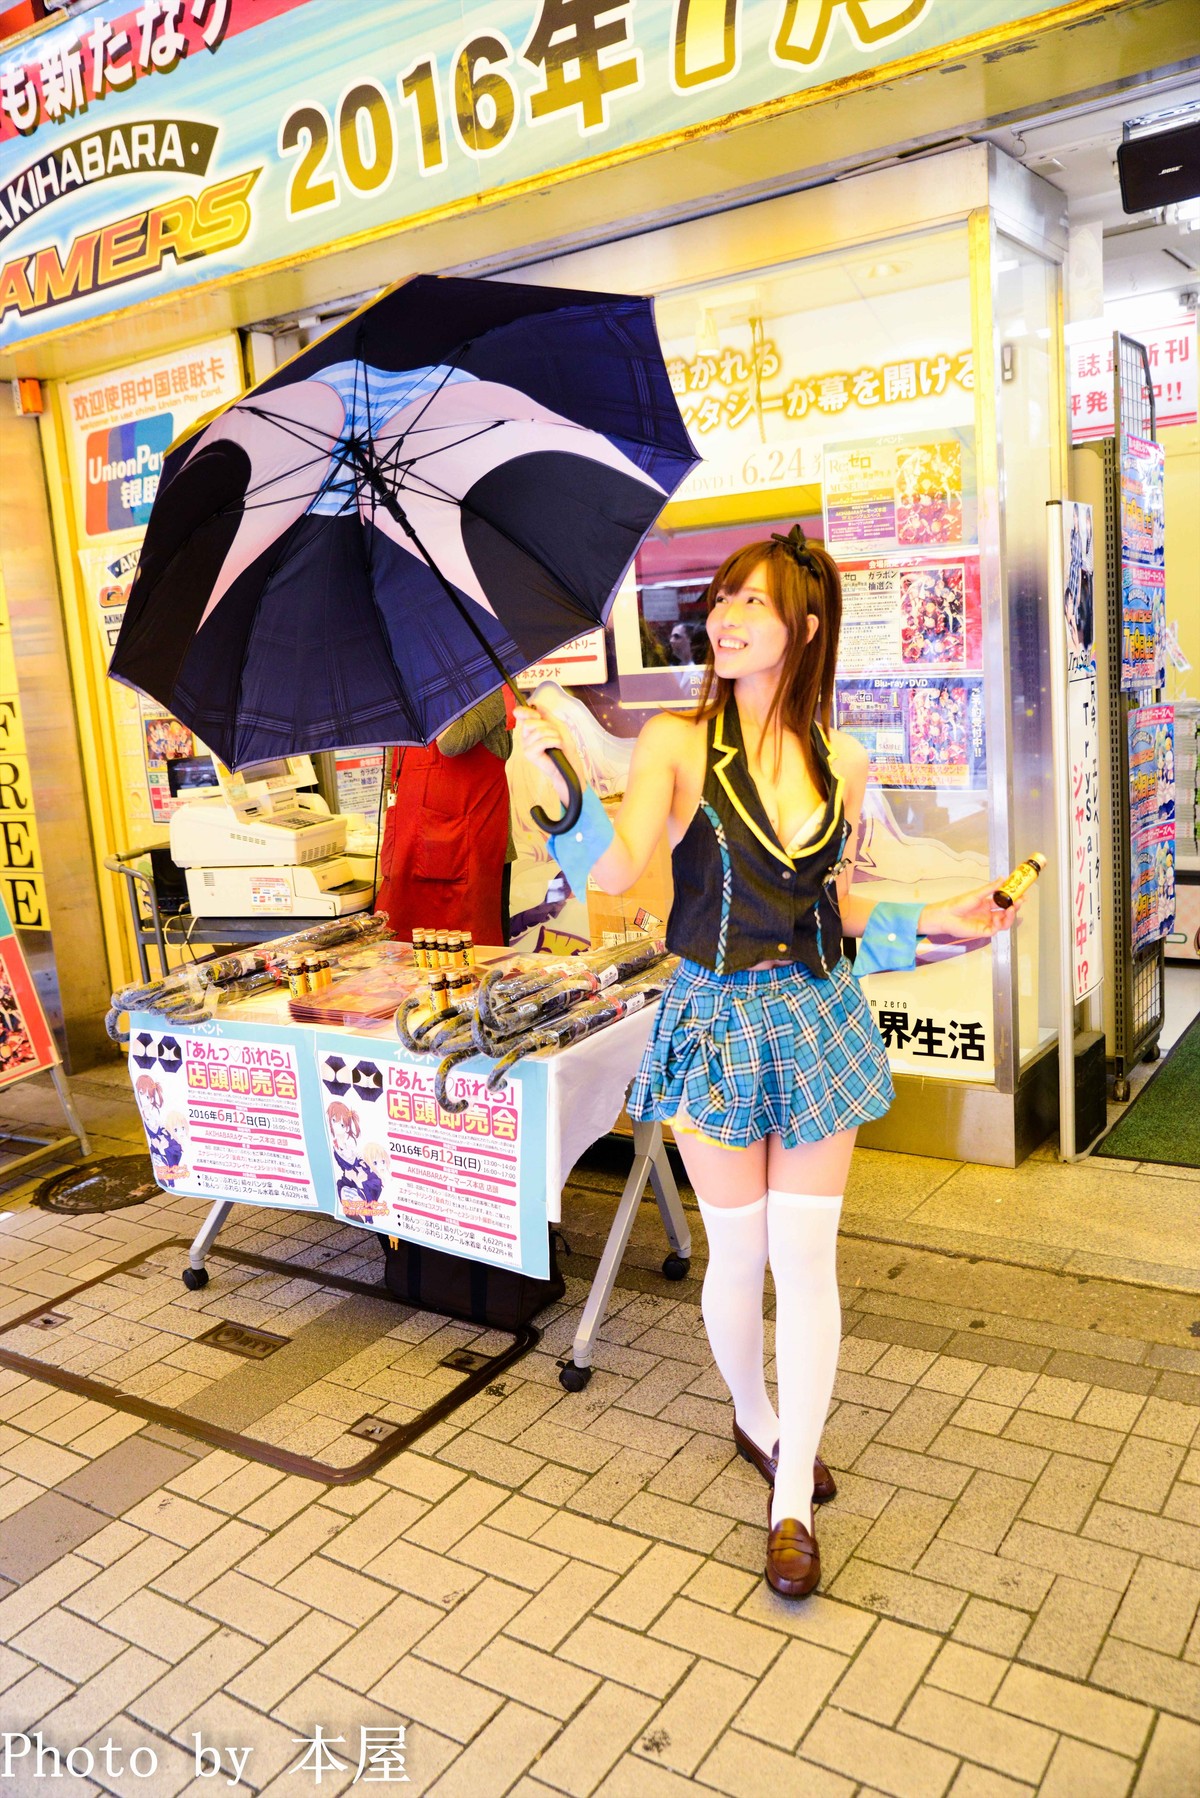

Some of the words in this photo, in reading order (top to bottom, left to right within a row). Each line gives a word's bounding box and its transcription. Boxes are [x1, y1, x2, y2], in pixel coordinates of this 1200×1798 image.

[72, 356, 225, 421] 欢迎使用中国银联卡
[741, 447, 806, 486] 6.24
[878, 1010, 986, 1062] 界生活
[185, 1060, 298, 1099] 店頭即売会
[188, 1108, 271, 1129] 2016年6月12日(日)
[386, 1089, 519, 1142] 店頭即売会
[389, 1141, 482, 1172] 2016年6月12日(日)
[407, 1166, 485, 1192] AKIHABARAゲーマーズ本店
